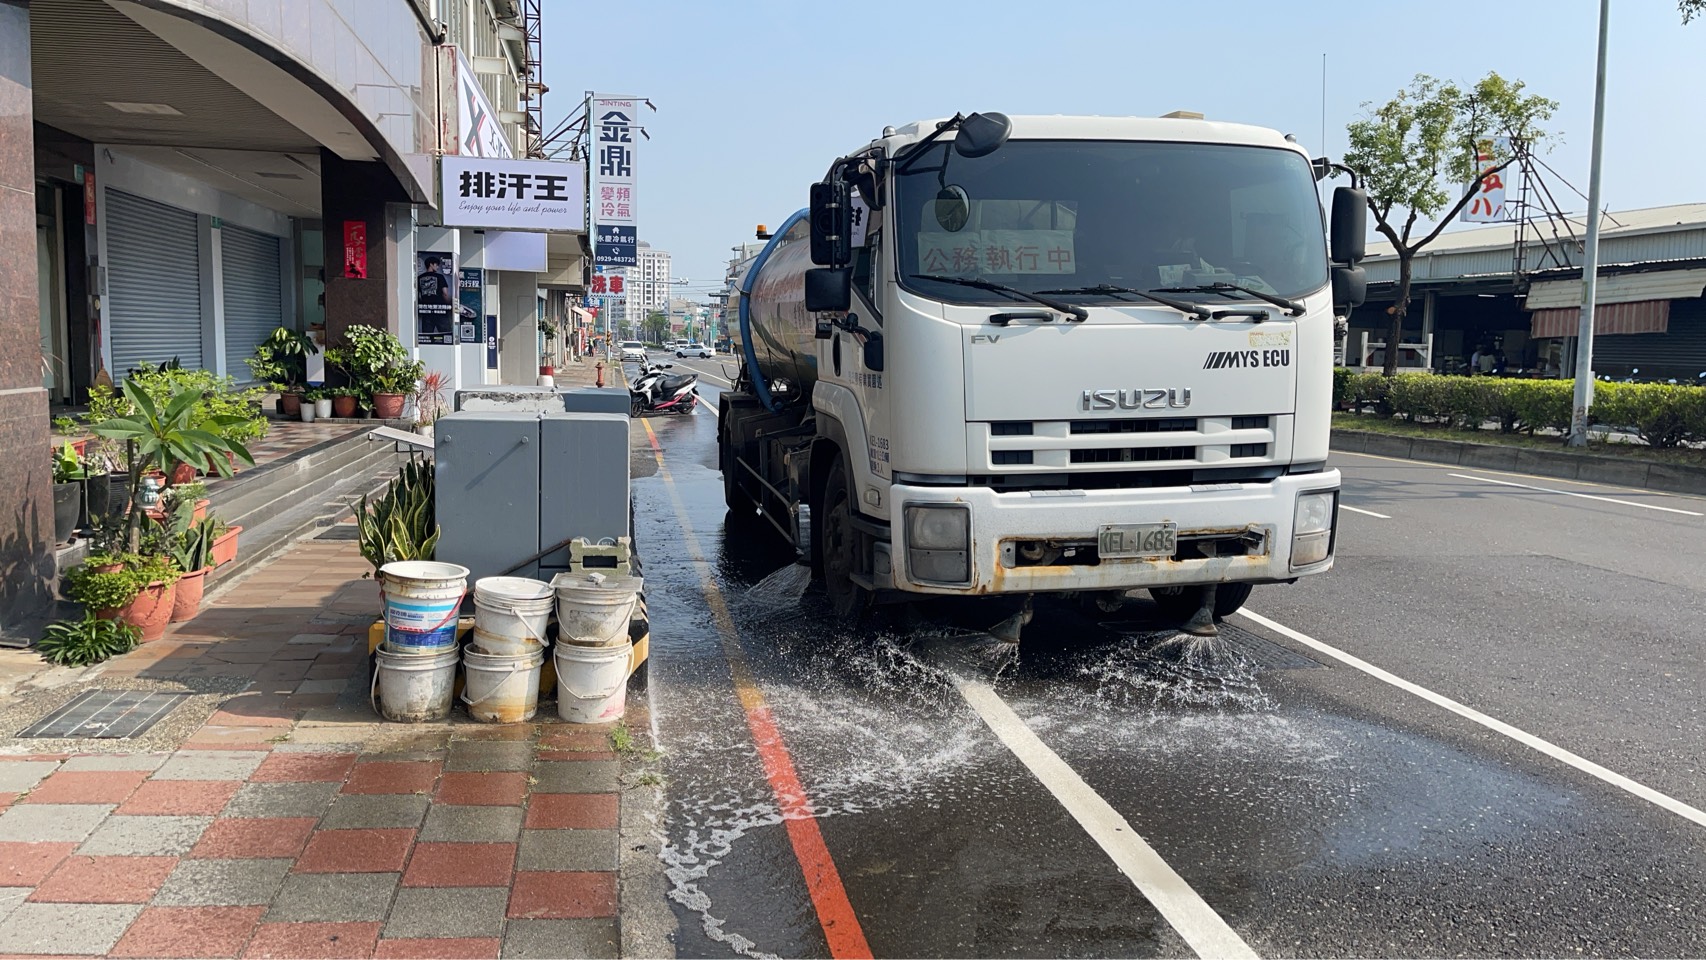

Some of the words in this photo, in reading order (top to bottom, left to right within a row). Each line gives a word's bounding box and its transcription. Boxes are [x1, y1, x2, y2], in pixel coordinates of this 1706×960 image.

[600, 111, 631, 176] 金鼎
[459, 171, 568, 201] 排汗王
[601, 187, 630, 201] 變頻
[459, 201, 484, 213] Enjoy
[486, 203, 505, 213] your
[507, 202, 521, 214] life
[523, 204, 540, 213] and
[541, 207, 567, 215] power
[601, 203, 630, 217] 冷氣
[923, 245, 1071, 273] 公務執行中
[591, 274, 624, 294] 洗車
[971, 335, 1000, 344] FV
[1263, 349, 1290, 367] ECU
[1083, 387, 1191, 411] ISUZU
